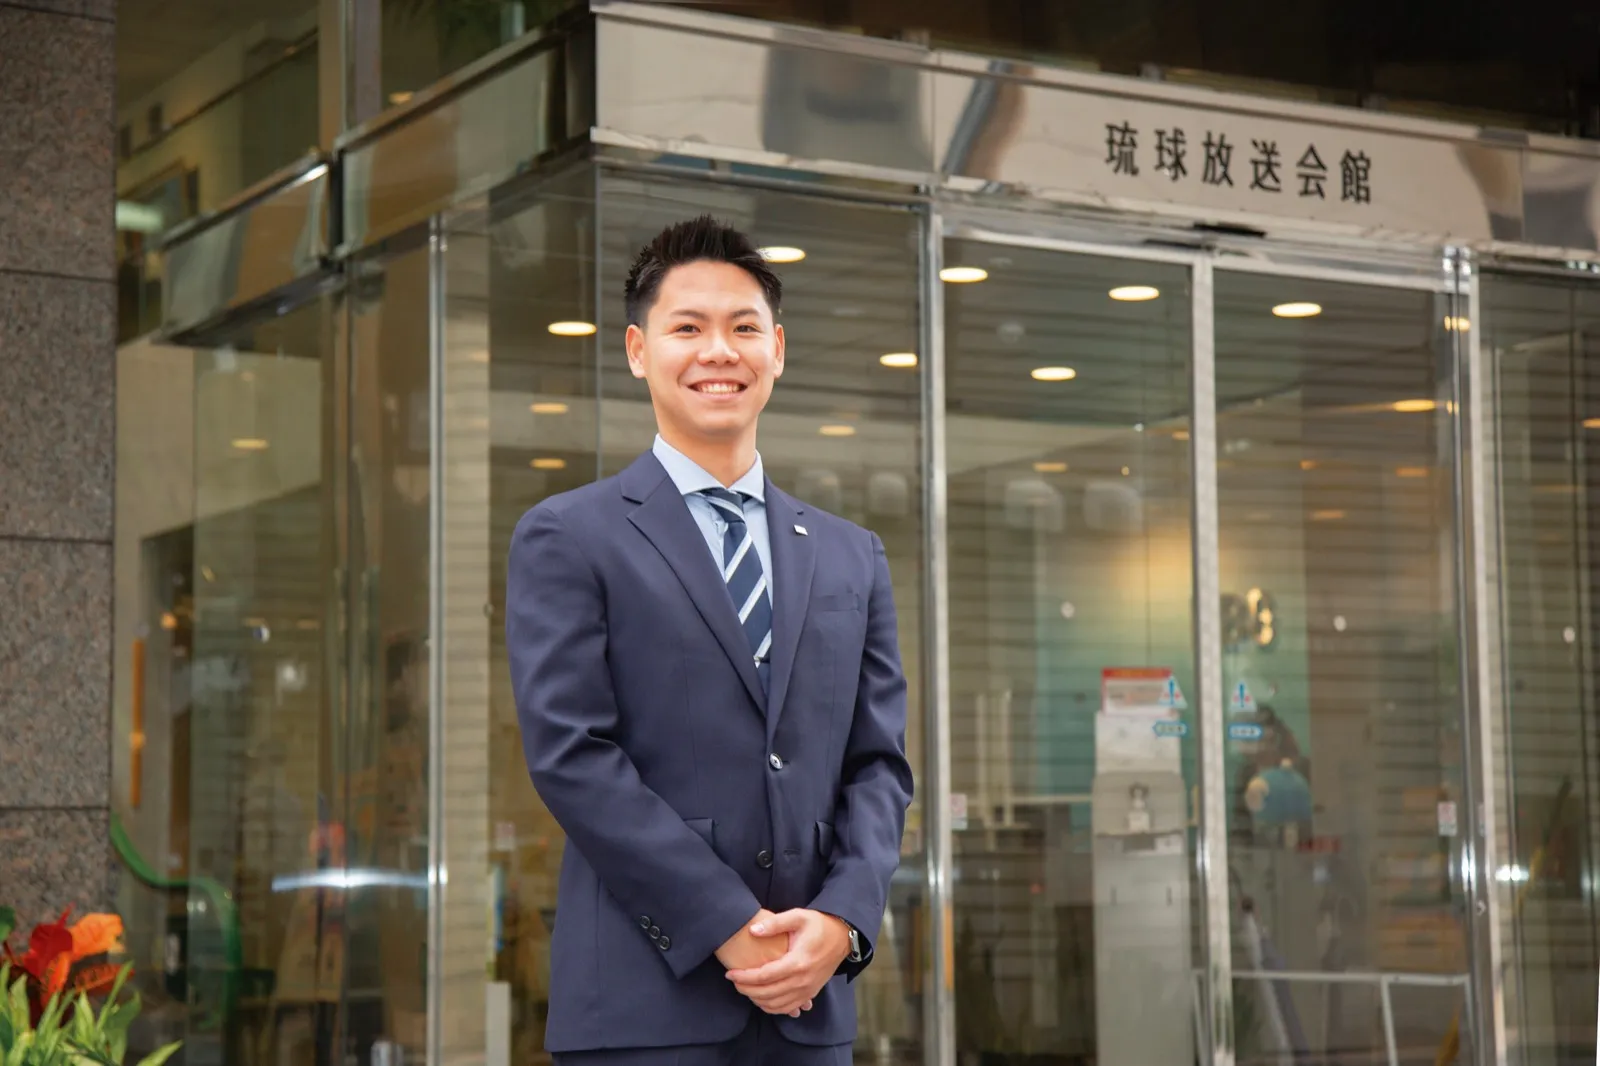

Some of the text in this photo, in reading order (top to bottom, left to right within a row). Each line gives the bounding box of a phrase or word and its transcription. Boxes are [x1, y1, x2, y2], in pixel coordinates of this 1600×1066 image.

[1105, 121, 1372, 204] 琉球放送会館
